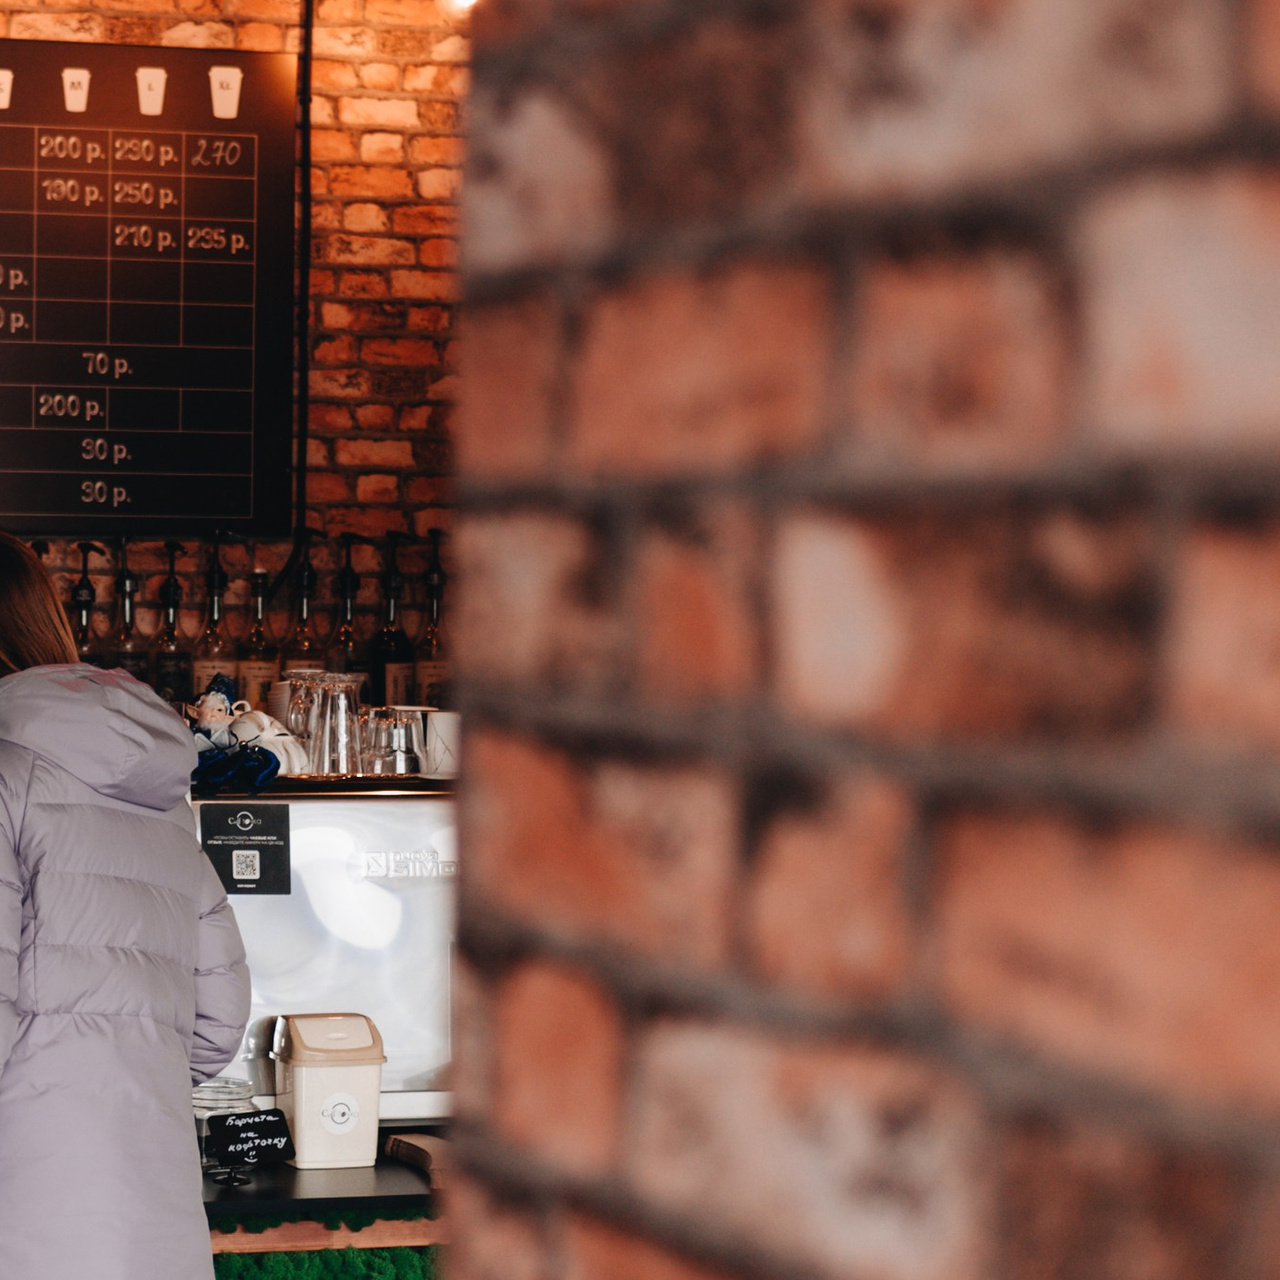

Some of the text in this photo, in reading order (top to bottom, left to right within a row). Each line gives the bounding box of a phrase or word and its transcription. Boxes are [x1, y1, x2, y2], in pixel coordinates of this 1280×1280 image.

[68, 80, 83, 92] M
[146, 81, 156, 92] L
[40, 134, 81, 159] 200
[114, 138, 154, 163] 230
[191, 139, 242, 167] 270
[113, 182, 154, 206] 250
[114, 224, 153, 249] 210
[187, 227, 226, 252] 235
[82, 352, 110, 376] 70
[39, 393, 80, 417] 200
[81, 438, 109, 462] 30
[80, 480, 109, 505] 30
